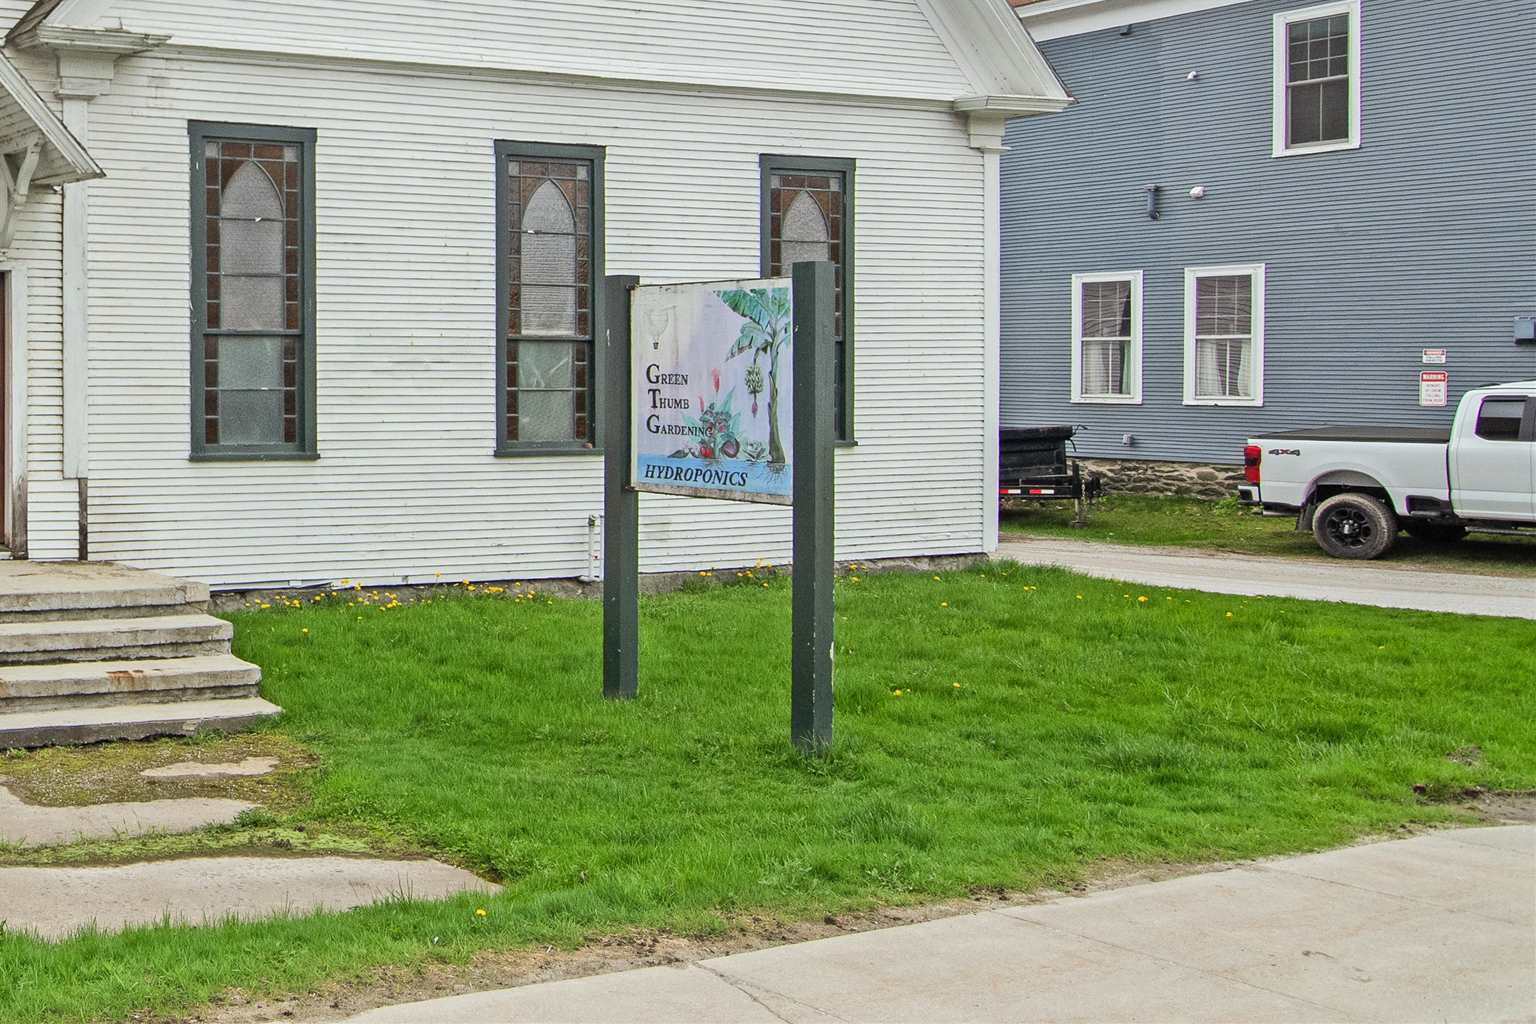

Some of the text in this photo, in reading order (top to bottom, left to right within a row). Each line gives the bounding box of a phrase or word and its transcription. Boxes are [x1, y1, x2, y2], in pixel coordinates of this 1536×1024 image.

[646, 363, 688, 385] GREEN
[647, 388, 690, 410] THUMB
[646, 414, 713, 437] GARDENING
[645, 464, 748, 487] HYDROPONICS
